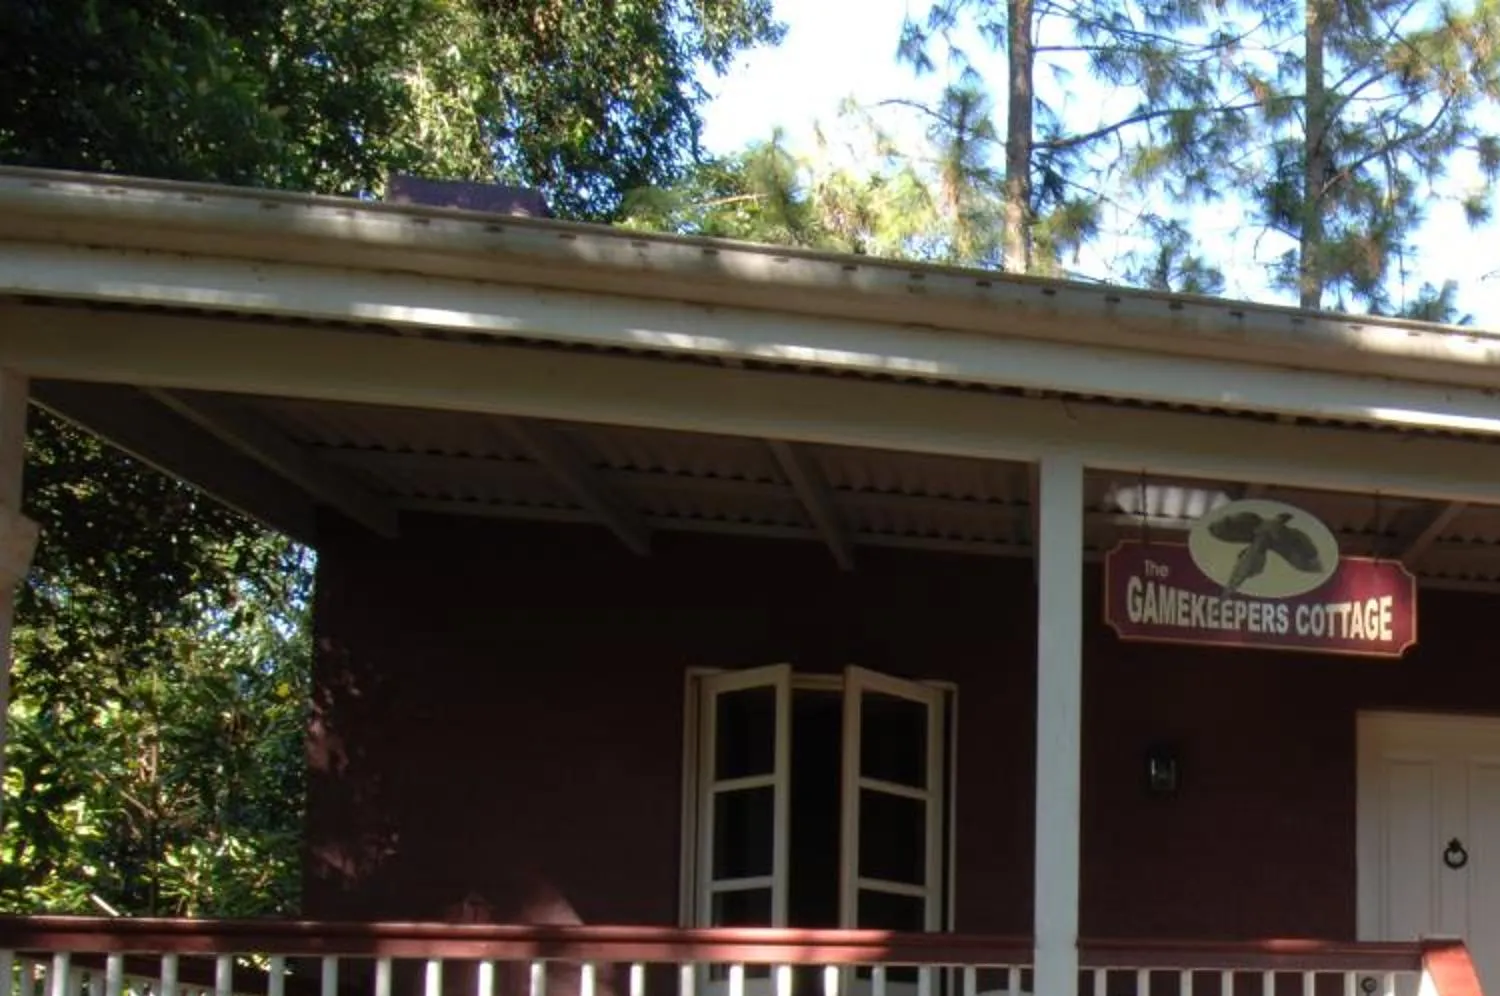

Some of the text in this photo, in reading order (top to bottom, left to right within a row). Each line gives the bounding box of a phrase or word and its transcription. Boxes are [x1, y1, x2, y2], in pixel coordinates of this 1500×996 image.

[1144, 560, 1169, 578] The
[1127, 576, 1393, 641] GAMEKEEPERS COTTAGE
